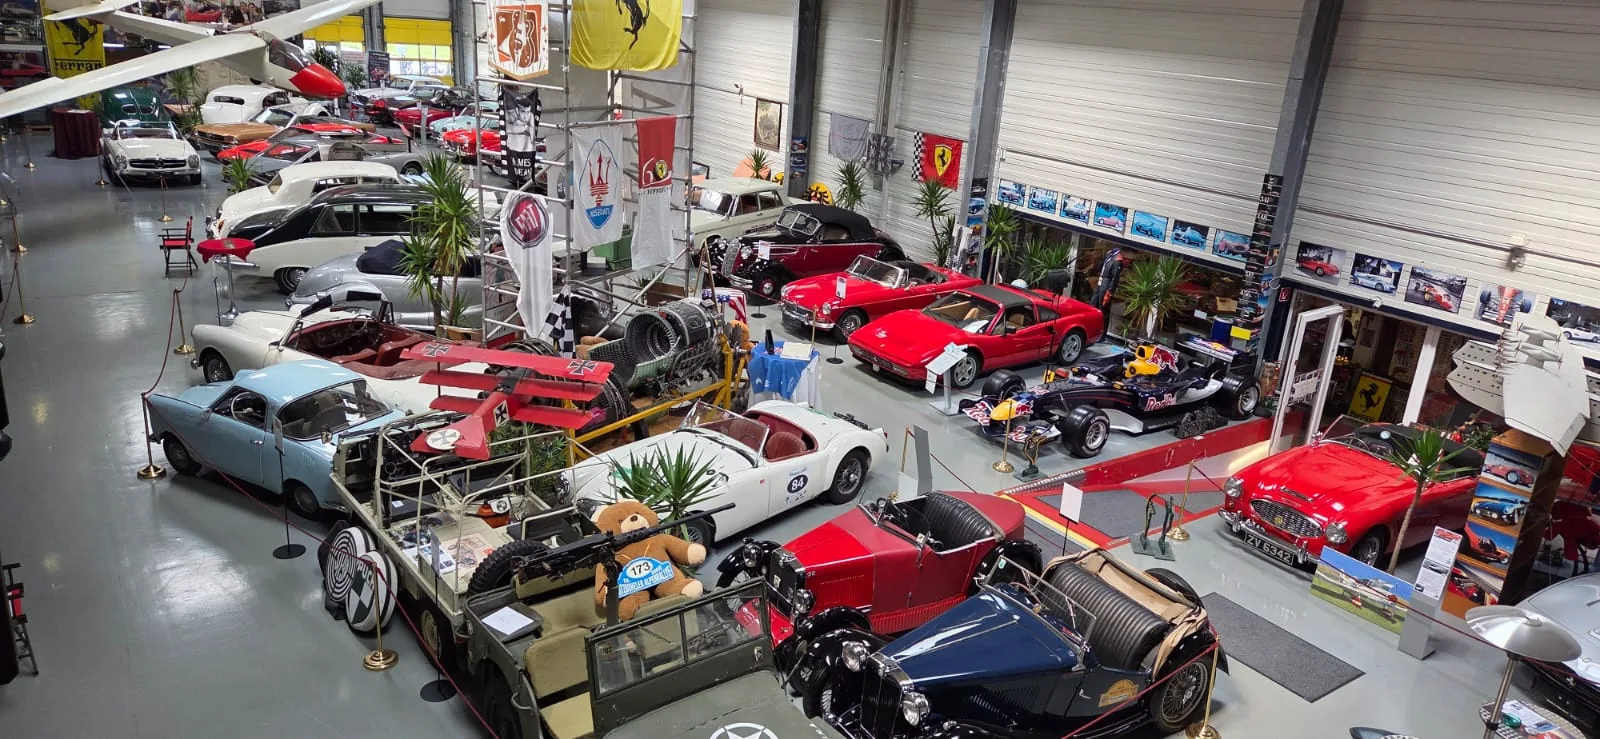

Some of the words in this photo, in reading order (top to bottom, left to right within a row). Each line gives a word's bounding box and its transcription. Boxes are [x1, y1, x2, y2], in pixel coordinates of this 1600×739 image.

[514, 203, 539, 233] FIAT
[791, 476, 804, 491] 84
[1246, 534, 1261, 548] ZV
[1262, 542, 1291, 564] 6342
[631, 561, 651, 577] 173
